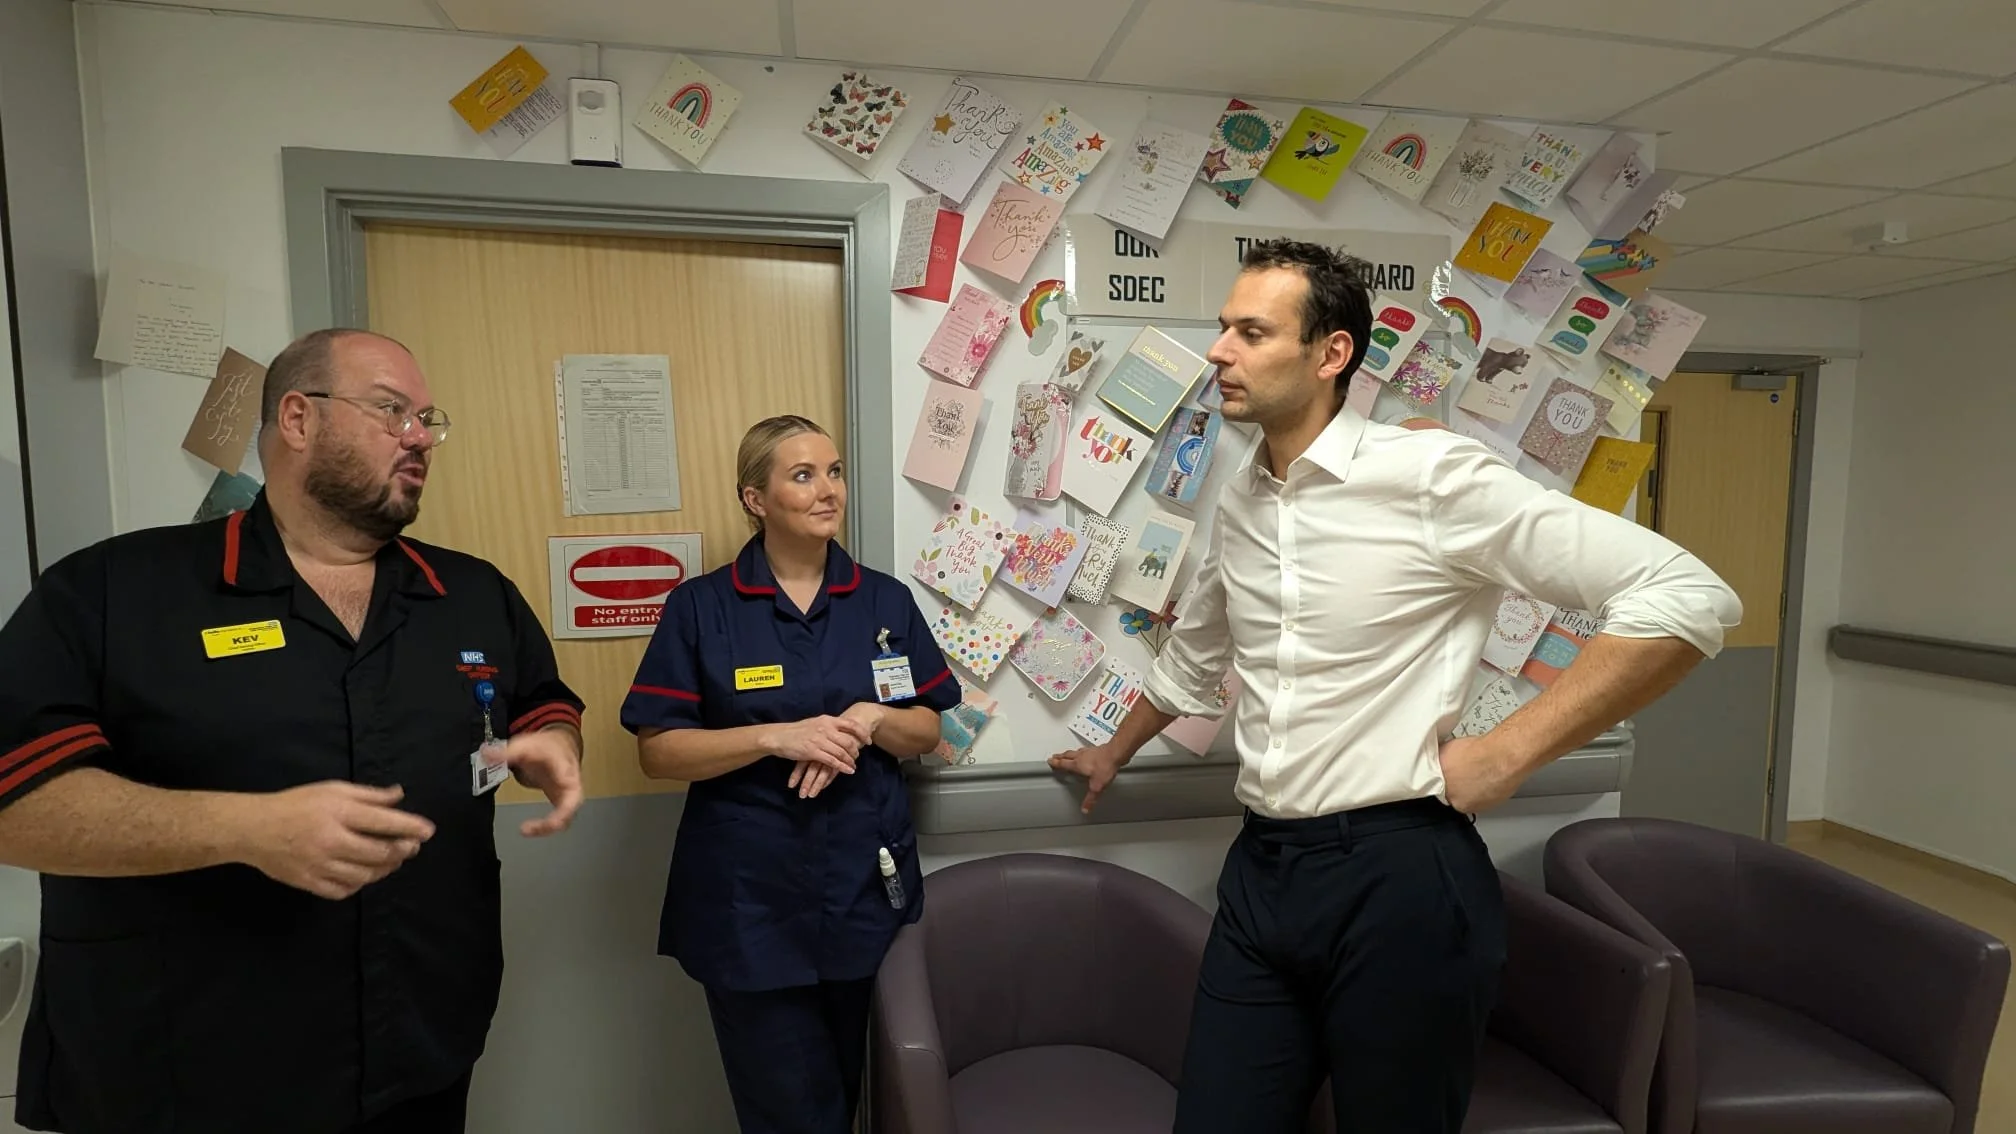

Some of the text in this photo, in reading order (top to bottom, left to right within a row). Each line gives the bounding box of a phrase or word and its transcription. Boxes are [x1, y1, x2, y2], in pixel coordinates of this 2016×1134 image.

[945, 77, 1019, 135] Thank
[649, 102, 710, 146] THANK YOU
[1057, 118, 1079, 136] You
[1040, 127, 1077, 160] Amazing
[1058, 129, 1073, 144] are
[1536, 132, 1582, 161] THANK
[1365, 151, 1424, 185] THANK YOU
[1521, 156, 1564, 183] VERY
[993, 199, 1046, 229] Thank
[1109, 274, 1165, 303] SDEC
[1142, 344, 1178, 373] thank you
[1559, 396, 1588, 417] THANK
[1554, 411, 1583, 430] YOU
[1080, 416, 1136, 462] thank
[1605, 465, 1619, 475] YOU
[1606, 457, 1628, 469] THANK
[964, 530, 986, 551] Great
[946, 546, 977, 568] Thank
[592, 615, 628, 624] staff
[594, 606, 663, 616] No entry
[1503, 603, 1533, 621] Thank
[1505, 614, 1523, 626] you
[232, 634, 259, 645] KEV
[464, 652, 484, 662] NHS
[743, 675, 775, 683] LAUREN
[1100, 668, 1140, 708] THAN
[1092, 693, 1127, 727] YOU
